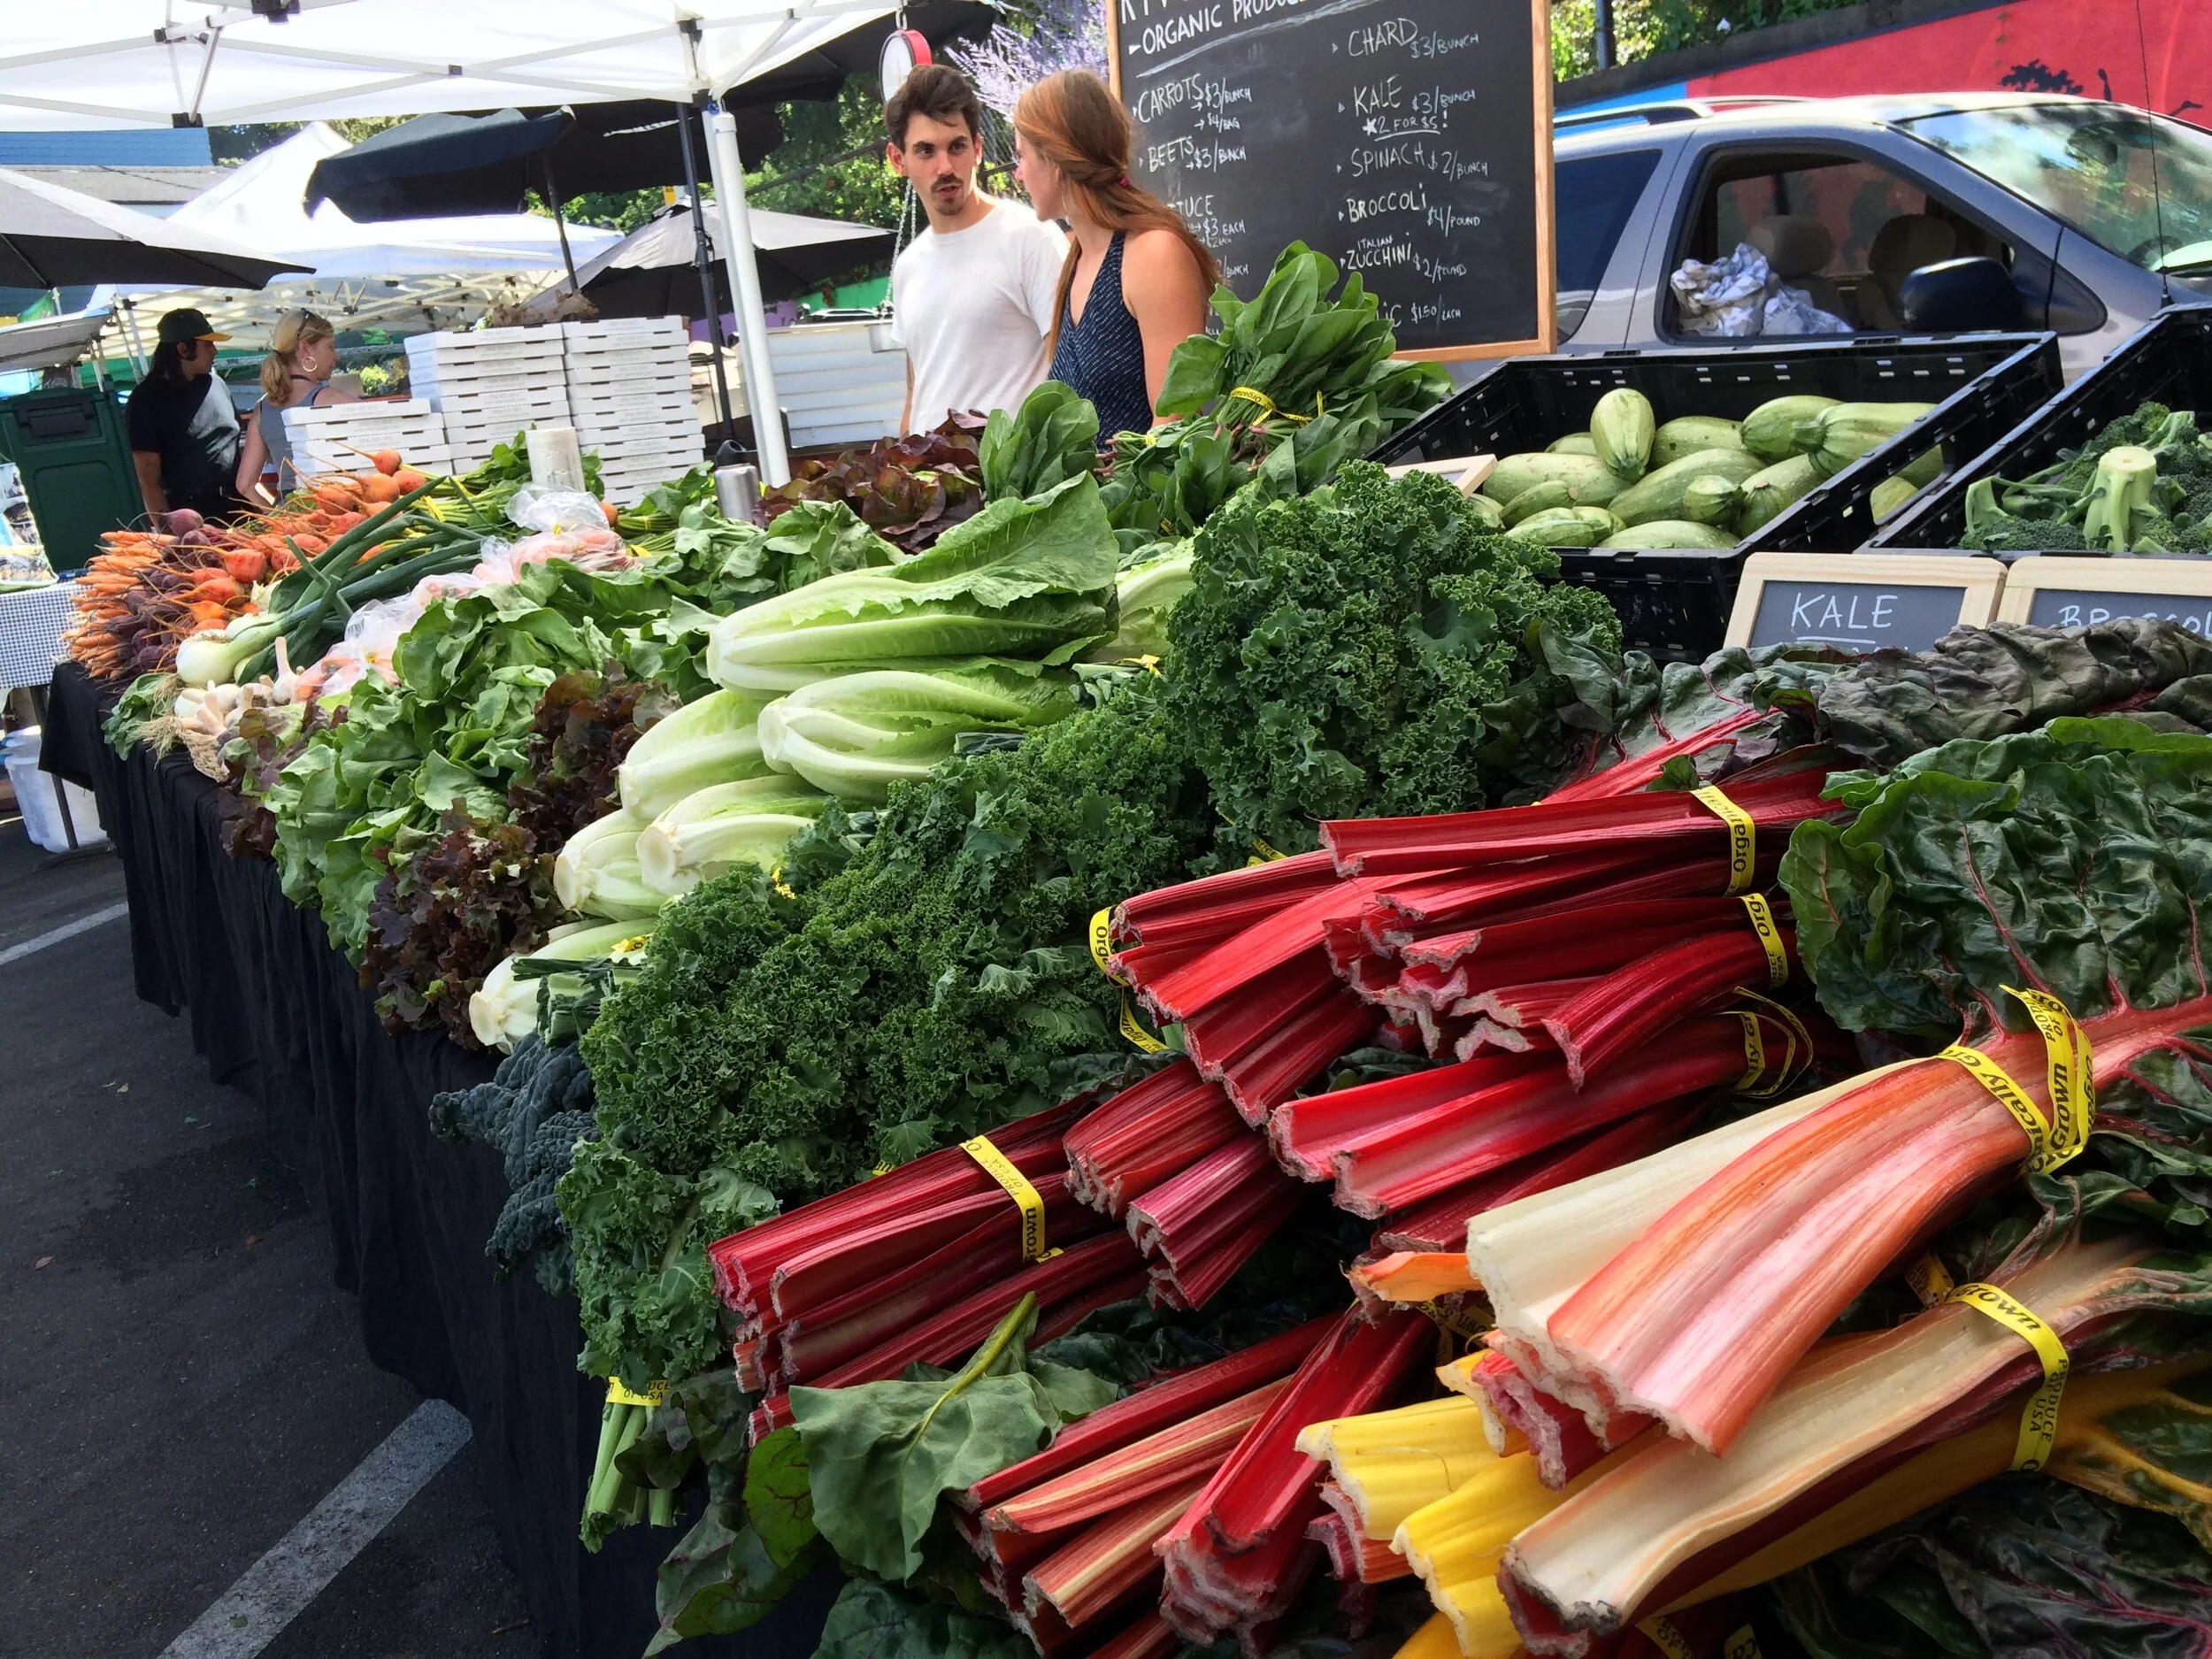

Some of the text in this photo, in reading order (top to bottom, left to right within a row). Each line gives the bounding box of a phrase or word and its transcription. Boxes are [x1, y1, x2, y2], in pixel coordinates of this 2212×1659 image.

[1141, 4, 1223, 55] ORGANIC
[1233, 0, 1303, 23] PROD
[1348, 18, 1418, 58] CHARD
[1138, 73, 1204, 124] CARROTS
[1353, 73, 1402, 117] KALE
[1394, 117, 1418, 132] FOR
[1148, 136, 1195, 173] BEETS
[1350, 141, 1425, 178] SPINACH
[1167, 195, 1216, 218] TUCE
[1222, 219, 1246, 236] EACH
[1356, 234, 1394, 251] ITALIAN
[1790, 593, 1900, 632] KALE
[2049, 1063, 2071, 1150] Grown
[2029, 1398, 2047, 1434] USA
